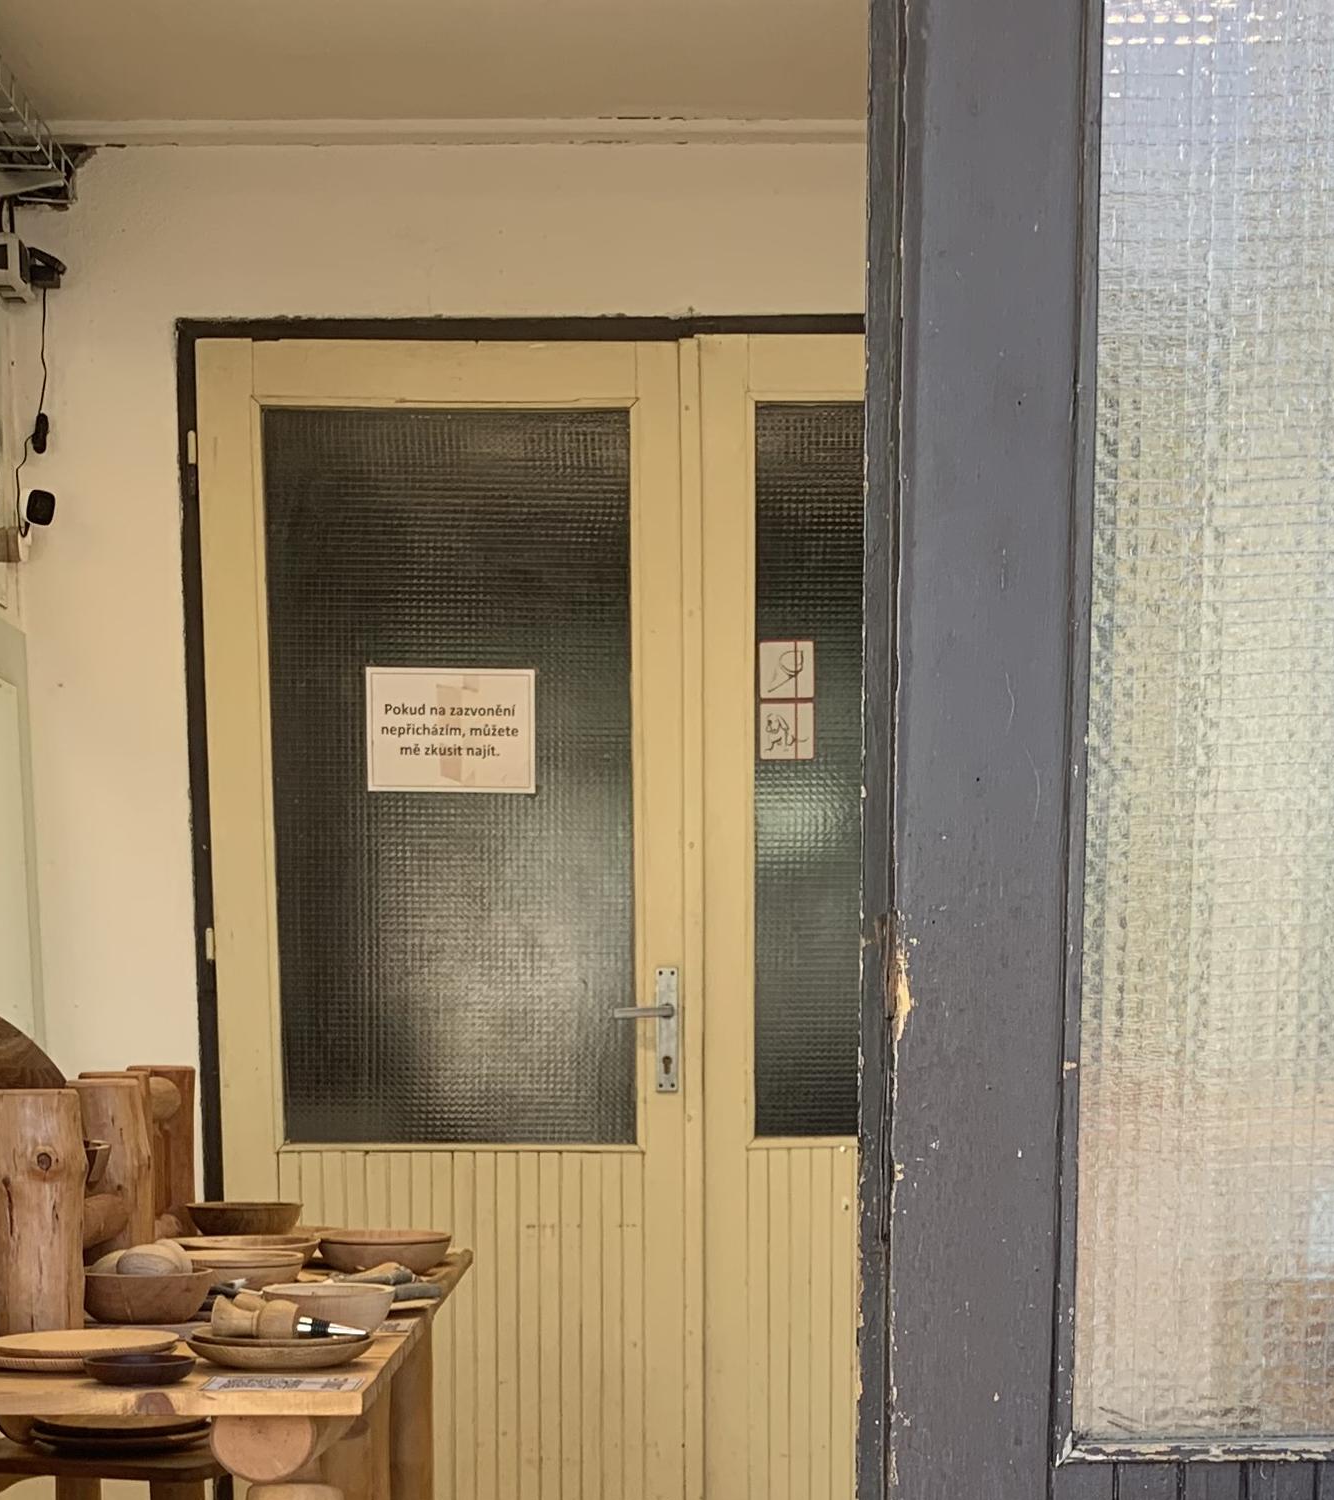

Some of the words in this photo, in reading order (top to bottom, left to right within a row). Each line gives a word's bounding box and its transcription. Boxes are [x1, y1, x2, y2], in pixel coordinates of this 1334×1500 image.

[384, 703, 426, 717] Pokud
[429, 706, 446, 717] na
[449, 703, 517, 718] zazvonění
[380, 723, 466, 739] nepřicházím,
[469, 723, 520, 739] můžete
[399, 743, 421, 757] mě
[424, 743, 463, 757] zkusit
[466, 743, 501, 760] najít.
